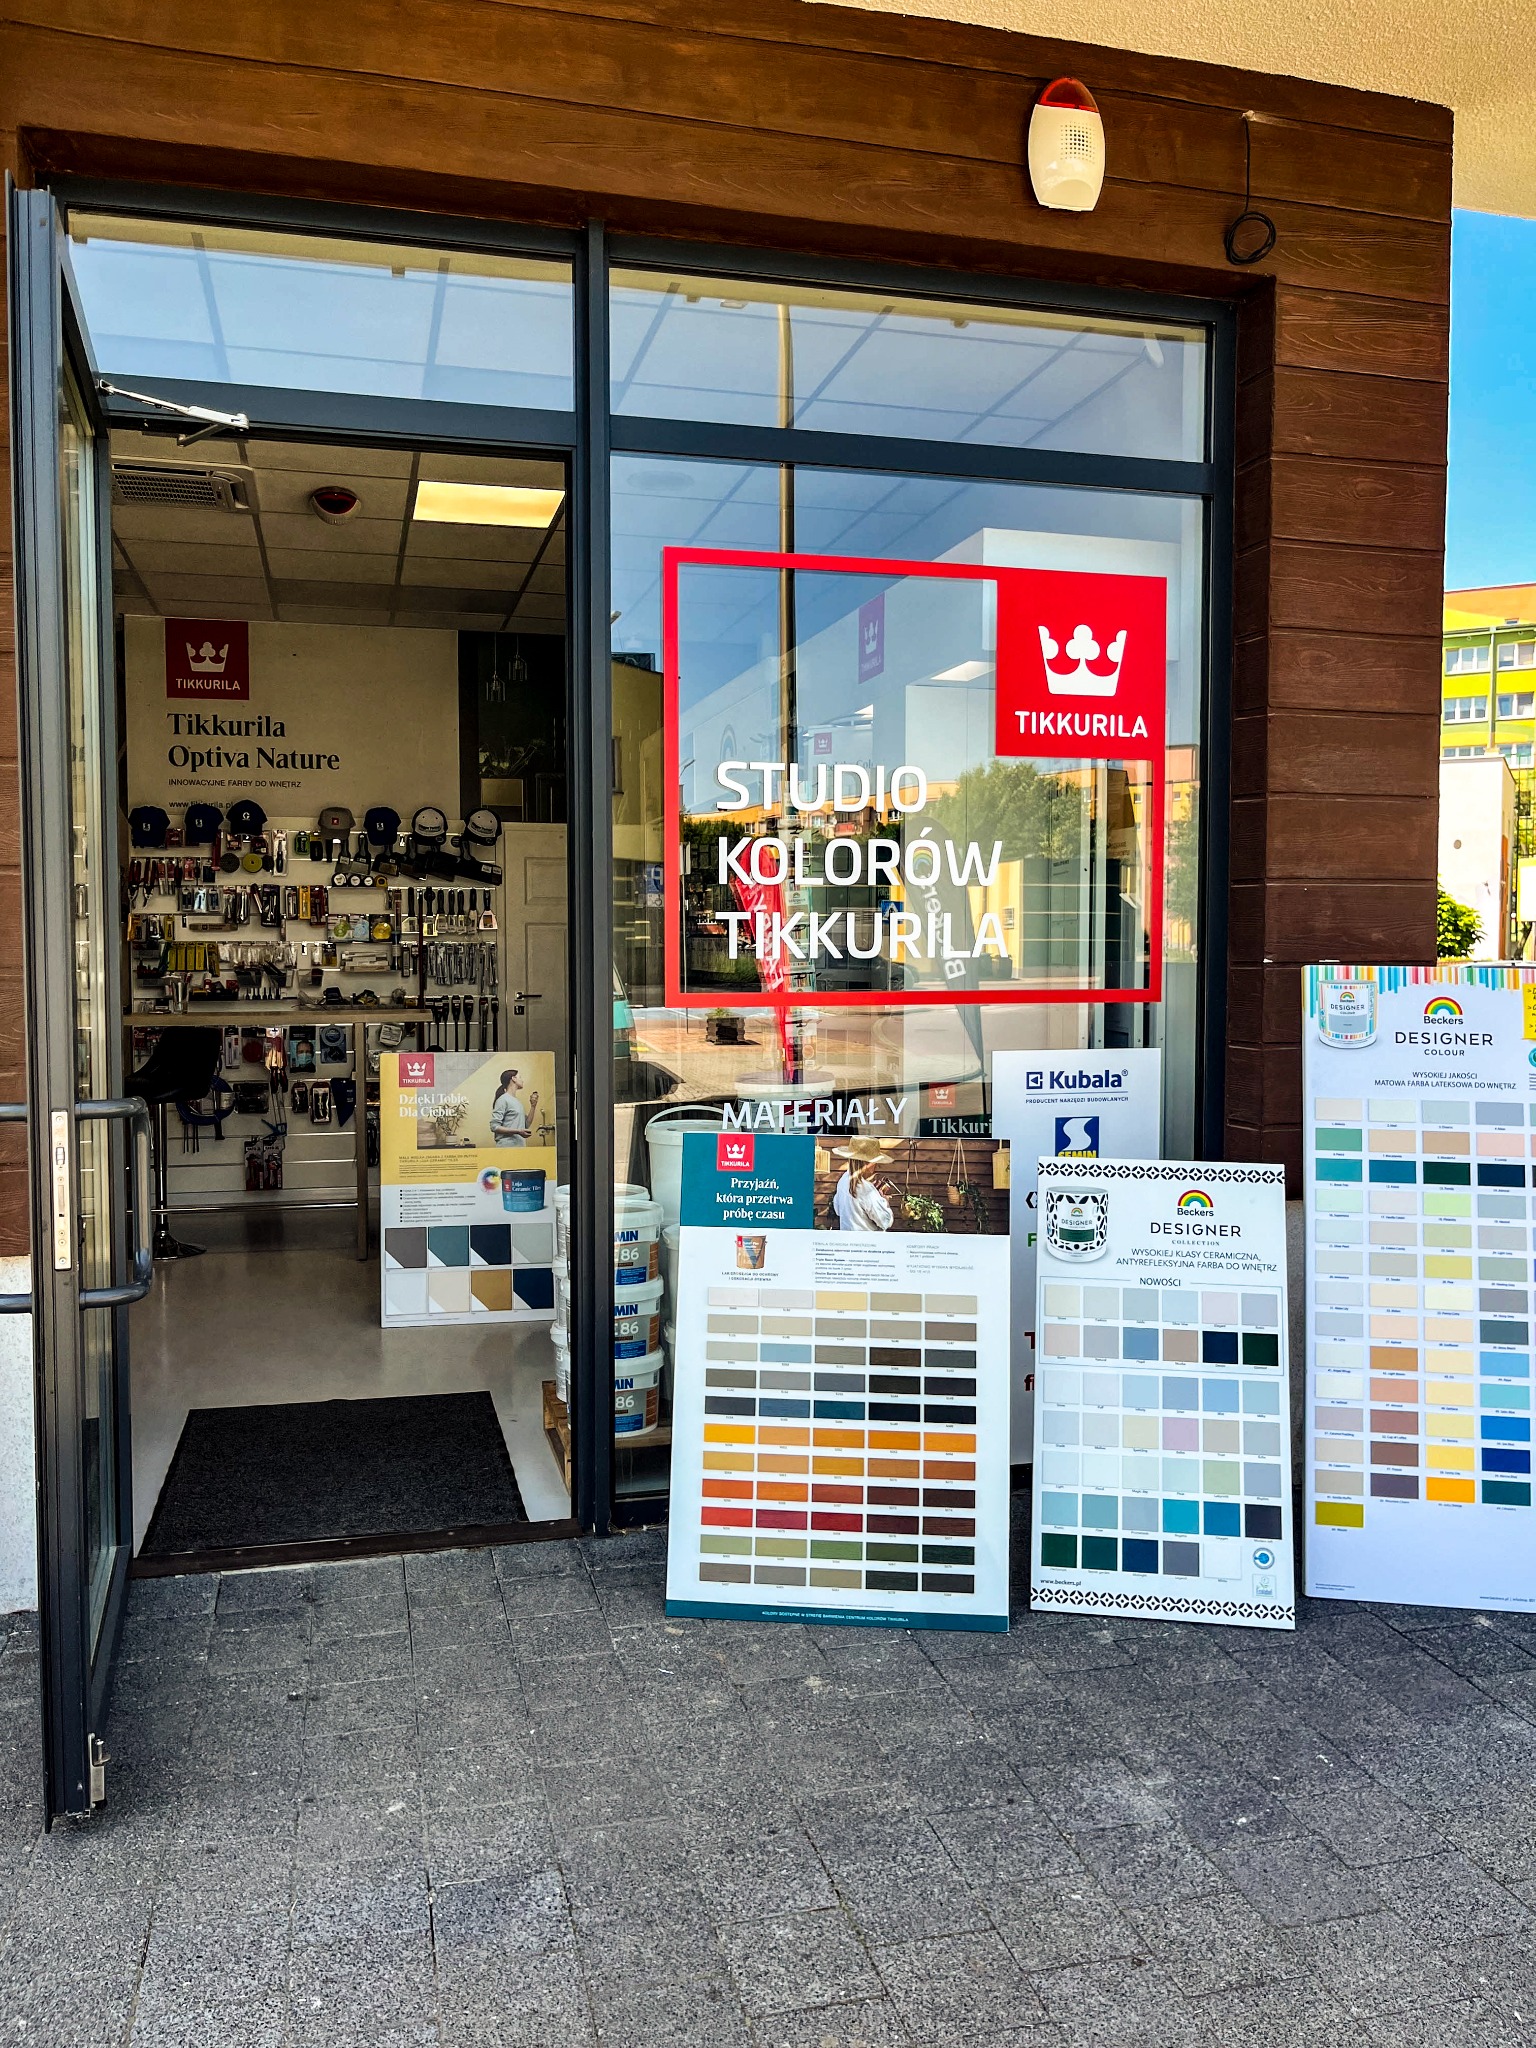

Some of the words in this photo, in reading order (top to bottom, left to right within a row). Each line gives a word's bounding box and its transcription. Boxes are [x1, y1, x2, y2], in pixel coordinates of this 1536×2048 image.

[175, 678, 241, 691] TIKKURILA
[166, 713, 287, 738] Tikkurila
[1014, 710, 1149, 739] TIKKURILA
[168, 745, 250, 773] Optiva
[256, 747, 341, 770] Nature
[168, 778, 226, 787] INNOWACYJNE
[227, 779, 253, 788] FARBY
[255, 780, 267, 788] DO
[268, 780, 302, 789] WNĘTRZ
[716, 761, 927, 814] STUDIO
[718, 827, 1003, 886] KOLORÓW
[716, 910, 1009, 960] TIKKURILA
[1330, 1003, 1365, 1011] DESIGNER
[1423, 1015, 1464, 1025] Beckers
[1395, 1031, 1493, 1046] DESIGNER
[1424, 1049, 1465, 1057] COLOUR
[1412, 1071, 1447, 1079] WYSOKIEJ
[1448, 1071, 1478, 1080] JAKOŚCI
[1374, 1079, 1406, 1087] MATOWA
[1407, 1080, 1430, 1088] FARBA
[1431, 1081, 1473, 1089] LATEKSOWA
[1487, 1082, 1517, 1091] WNĘTRZ
[399, 1093, 435, 1107] Dzięki
[399, 1107, 418, 1117] Dla
[722, 1098, 909, 1130] MATERIAŁY
[720, 1160, 750, 1168] TIKKURILA
[730, 1177, 780, 1190] Przyjaźń,
[716, 1192, 744, 1205] która
[745, 1194, 793, 1206] przetrwa
[723, 1207, 753, 1221] próbę
[755, 1210, 785, 1220] czasu
[1176, 1207, 1214, 1217] Beckers
[1061, 1218, 1093, 1226] DESIGNER
[1150, 1222, 1242, 1238] DESIGNER
[1131, 1248, 1173, 1258] WYSOKIEJ
[1174, 1250, 1201, 1259] KLASY
[1202, 1250, 1262, 1262] CERAMICZNA,
[1116, 1257, 1195, 1268] ANTYREFLEKSYJNA
[1196, 1260, 1224, 1269] FARBA
[1225, 1261, 1240, 1270] DO
[1241, 1262, 1278, 1272] WNĘTRZ
[1139, 1276, 1181, 1287] NOWOŚCI
[615, 1395, 635, 1408] 86
